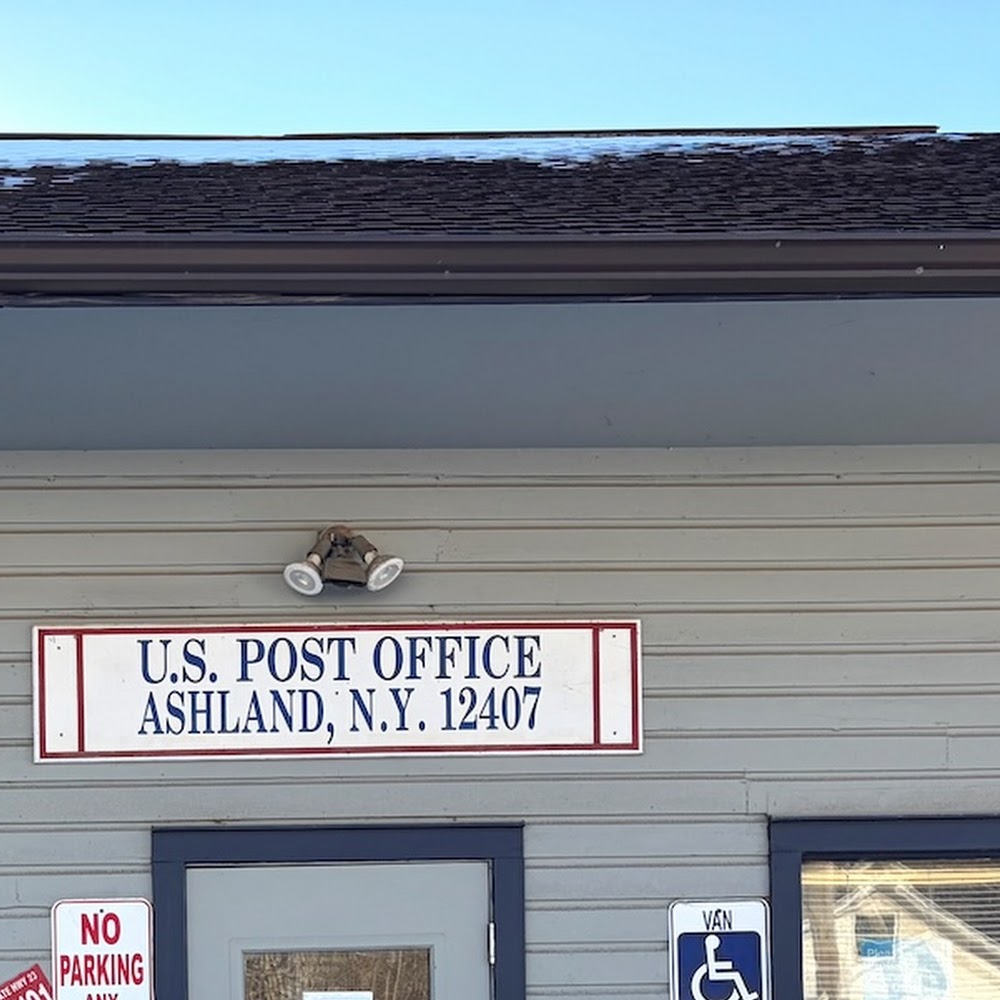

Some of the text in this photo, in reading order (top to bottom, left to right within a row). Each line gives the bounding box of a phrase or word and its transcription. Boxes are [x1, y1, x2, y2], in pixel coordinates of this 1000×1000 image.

[137, 634, 542, 684] U.S. POST OFFICE
[137, 686, 542, 744] ASHLAND, N.Y. 12407
[81, 912, 121, 945] NO
[702, 909, 733, 931] VAN
[60, 953, 144, 986] PARKING
